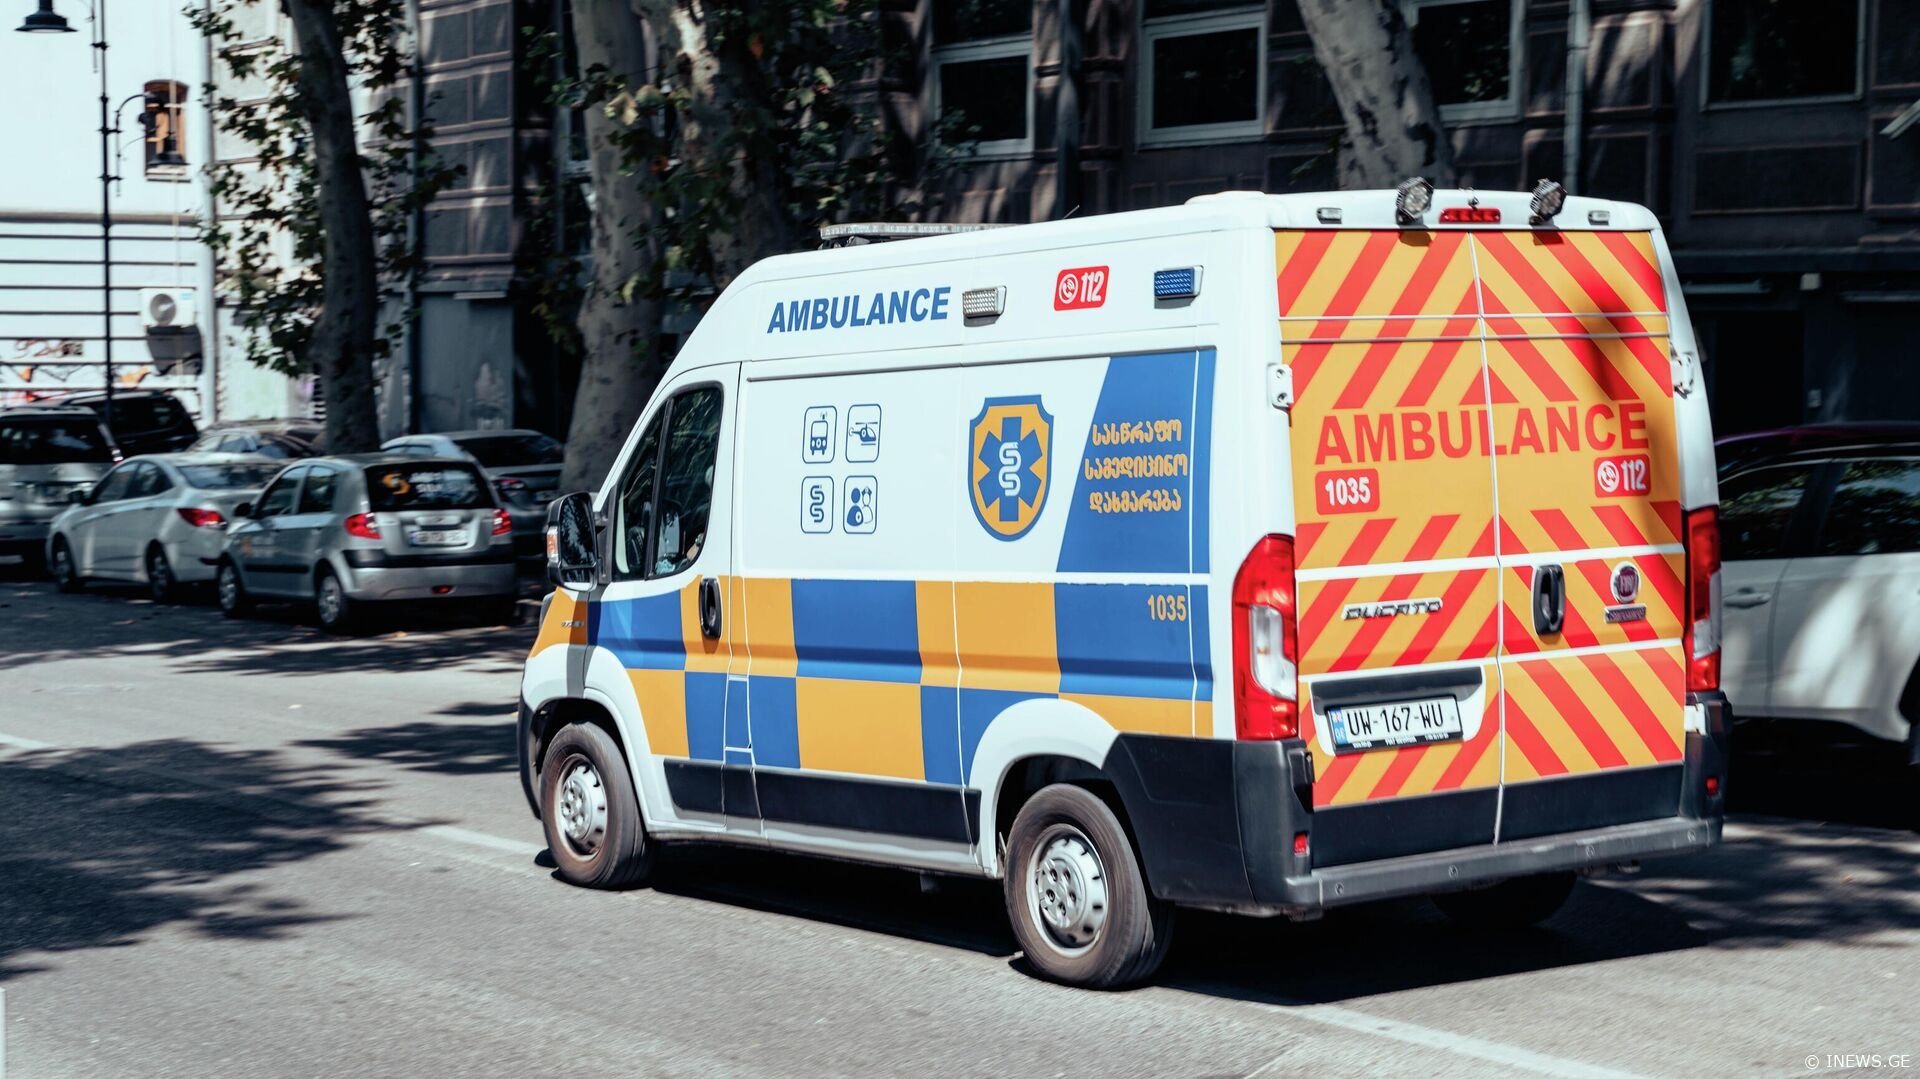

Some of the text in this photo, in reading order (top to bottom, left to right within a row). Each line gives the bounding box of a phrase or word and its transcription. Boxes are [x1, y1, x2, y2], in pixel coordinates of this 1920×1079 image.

[1080, 270, 1105, 303] 112
[767, 286, 951, 334] AMBULANCE
[1092, 419, 1182, 446] სასწრაფო
[1314, 403, 1649, 465] AMBULANCE
[1084, 453, 1188, 480] სამედიცინო
[1620, 459, 1647, 492] 112
[1089, 489, 1182, 514] დახმარება
[1325, 476, 1372, 507] 1035
[1148, 594, 1187, 622] 1035
[1343, 598, 1442, 621] DUCATO
[1347, 702, 1444, 736] UW-167-WU
